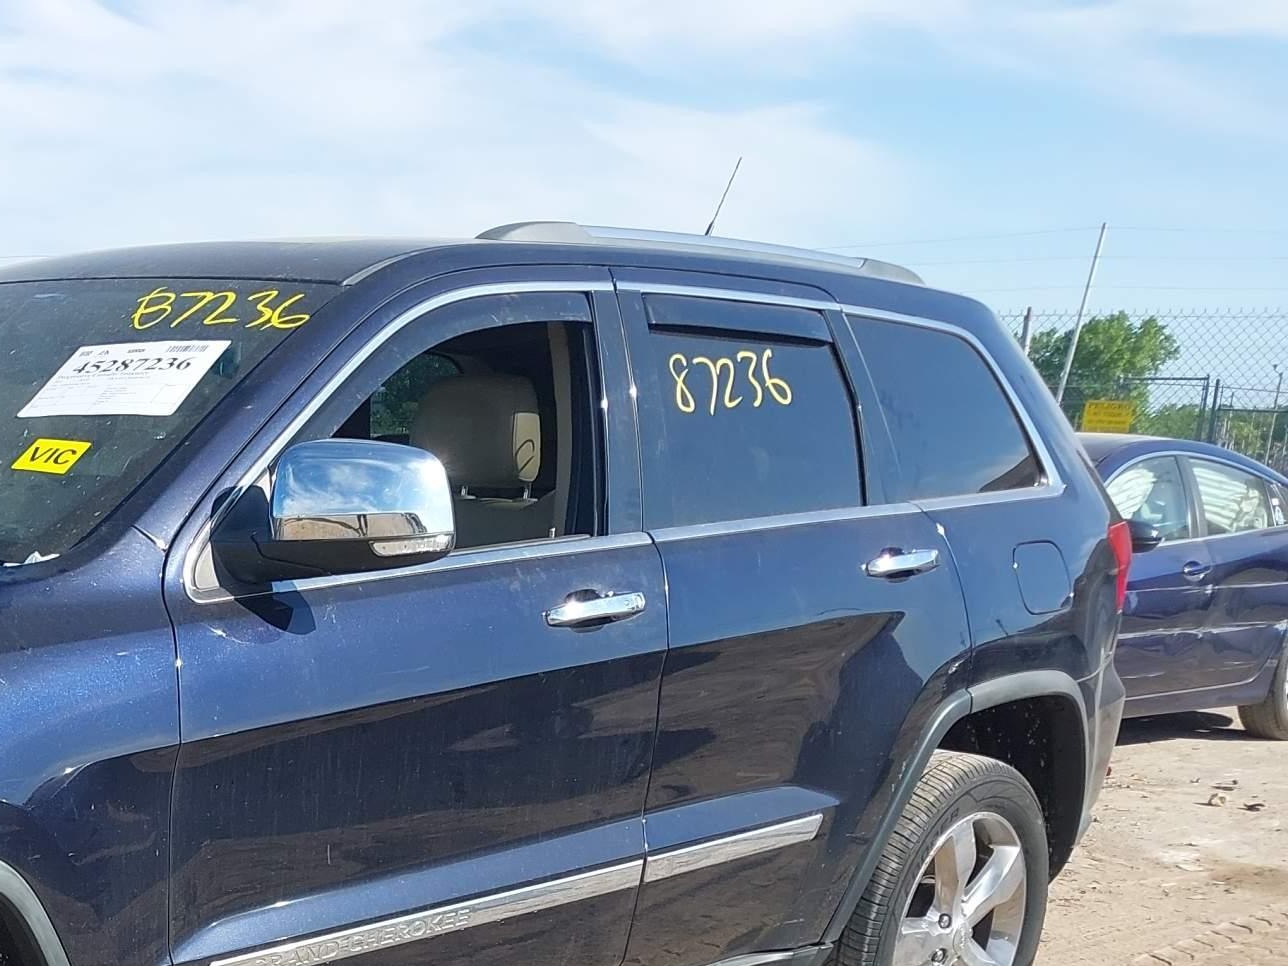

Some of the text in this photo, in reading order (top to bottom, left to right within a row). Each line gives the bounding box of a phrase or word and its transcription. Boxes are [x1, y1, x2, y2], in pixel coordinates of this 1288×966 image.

[73, 357, 196, 373] 45287236
[669, 348, 792, 416] 87236
[28, 446, 78, 465] VIC
[349, 908, 471, 952] CHEROKEE
